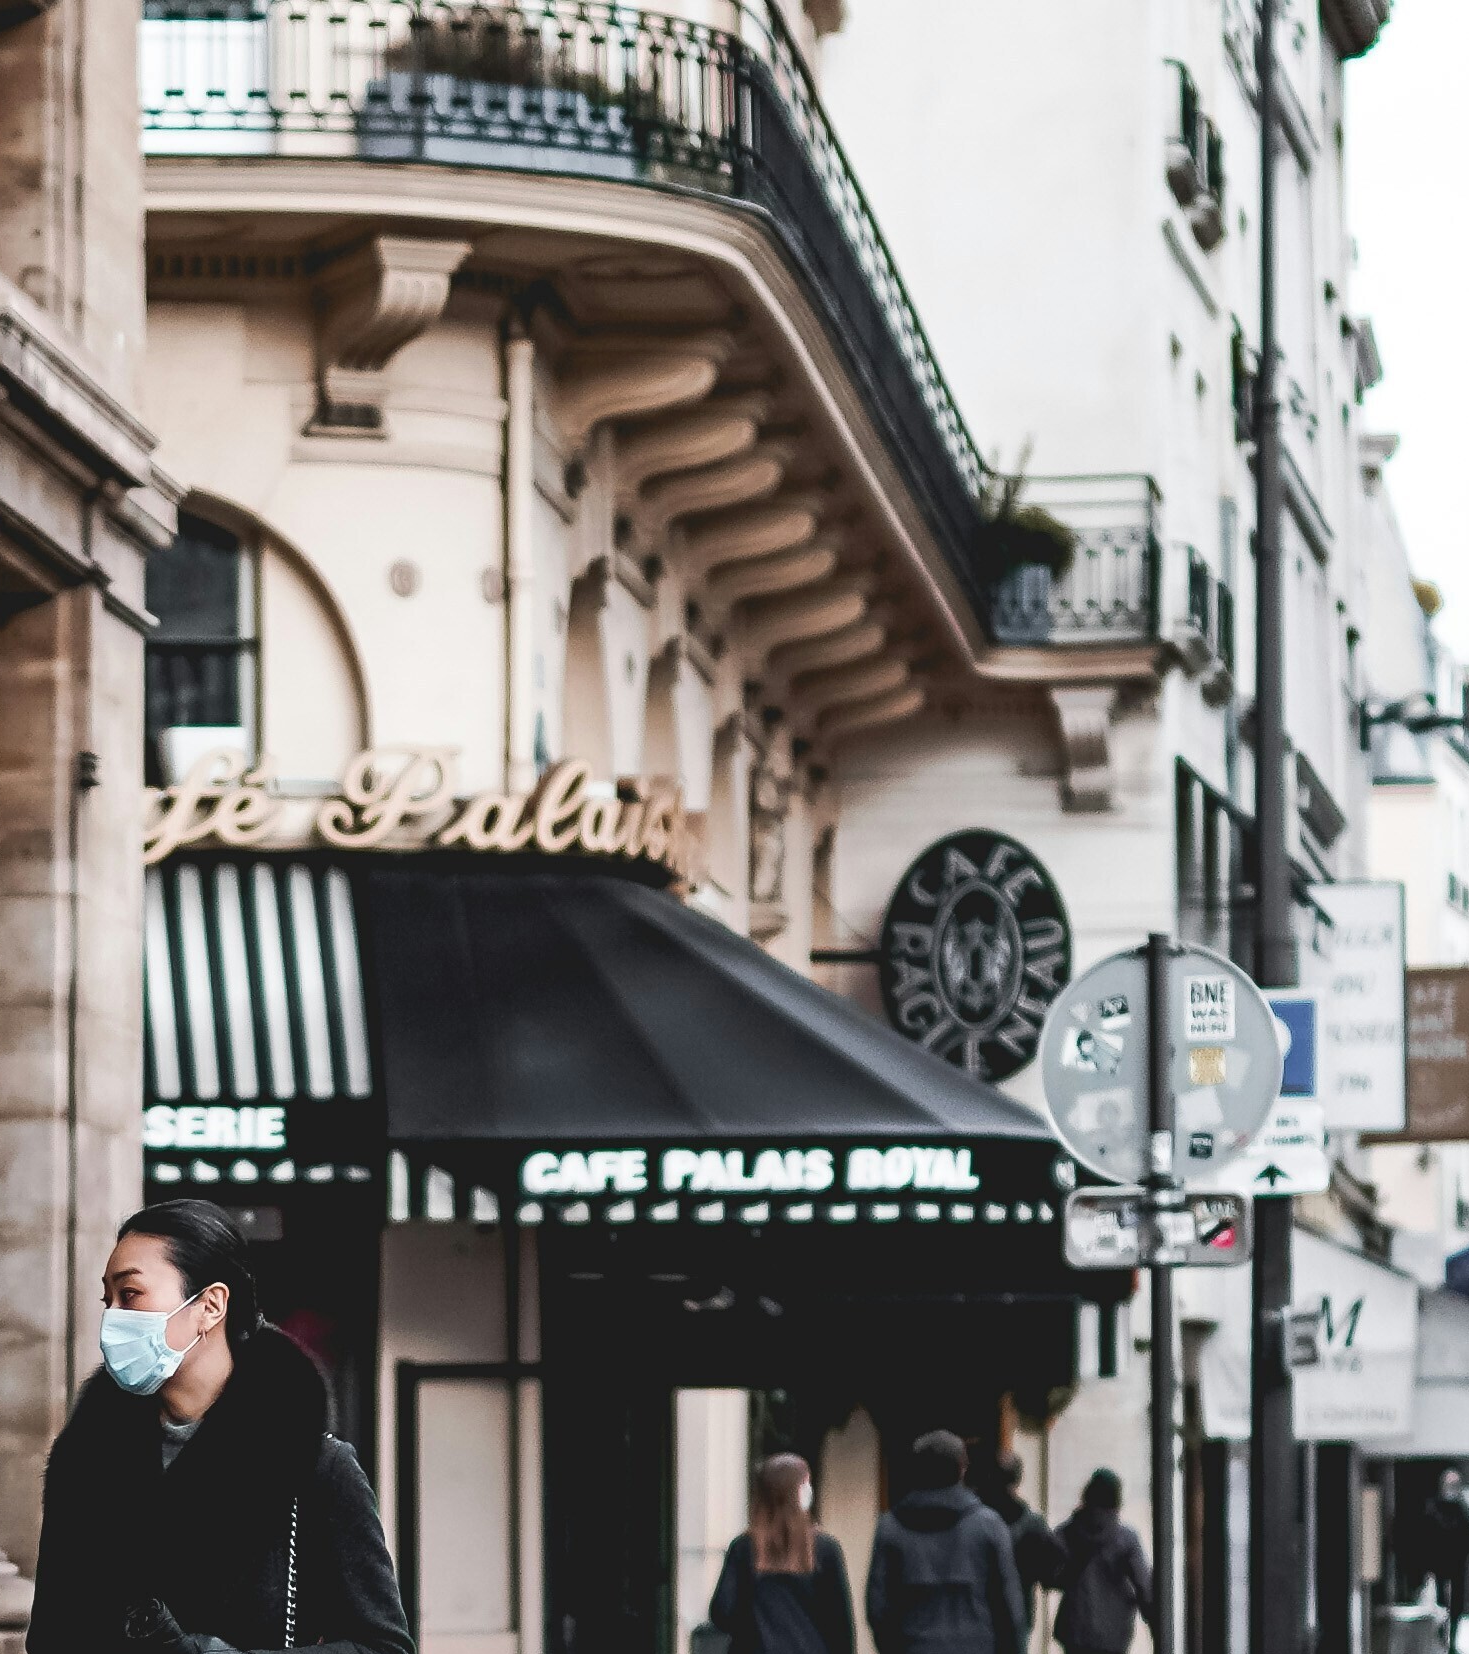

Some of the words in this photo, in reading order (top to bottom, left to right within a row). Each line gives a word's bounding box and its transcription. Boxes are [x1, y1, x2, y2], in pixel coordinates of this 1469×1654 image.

[143, 745, 278, 866] fé
[318, 745, 674, 864] Palais
[522, 1149, 648, 1192] CAFE
[661, 1147, 834, 1192] PALAIS
[847, 1146, 981, 1191] ROYAL
